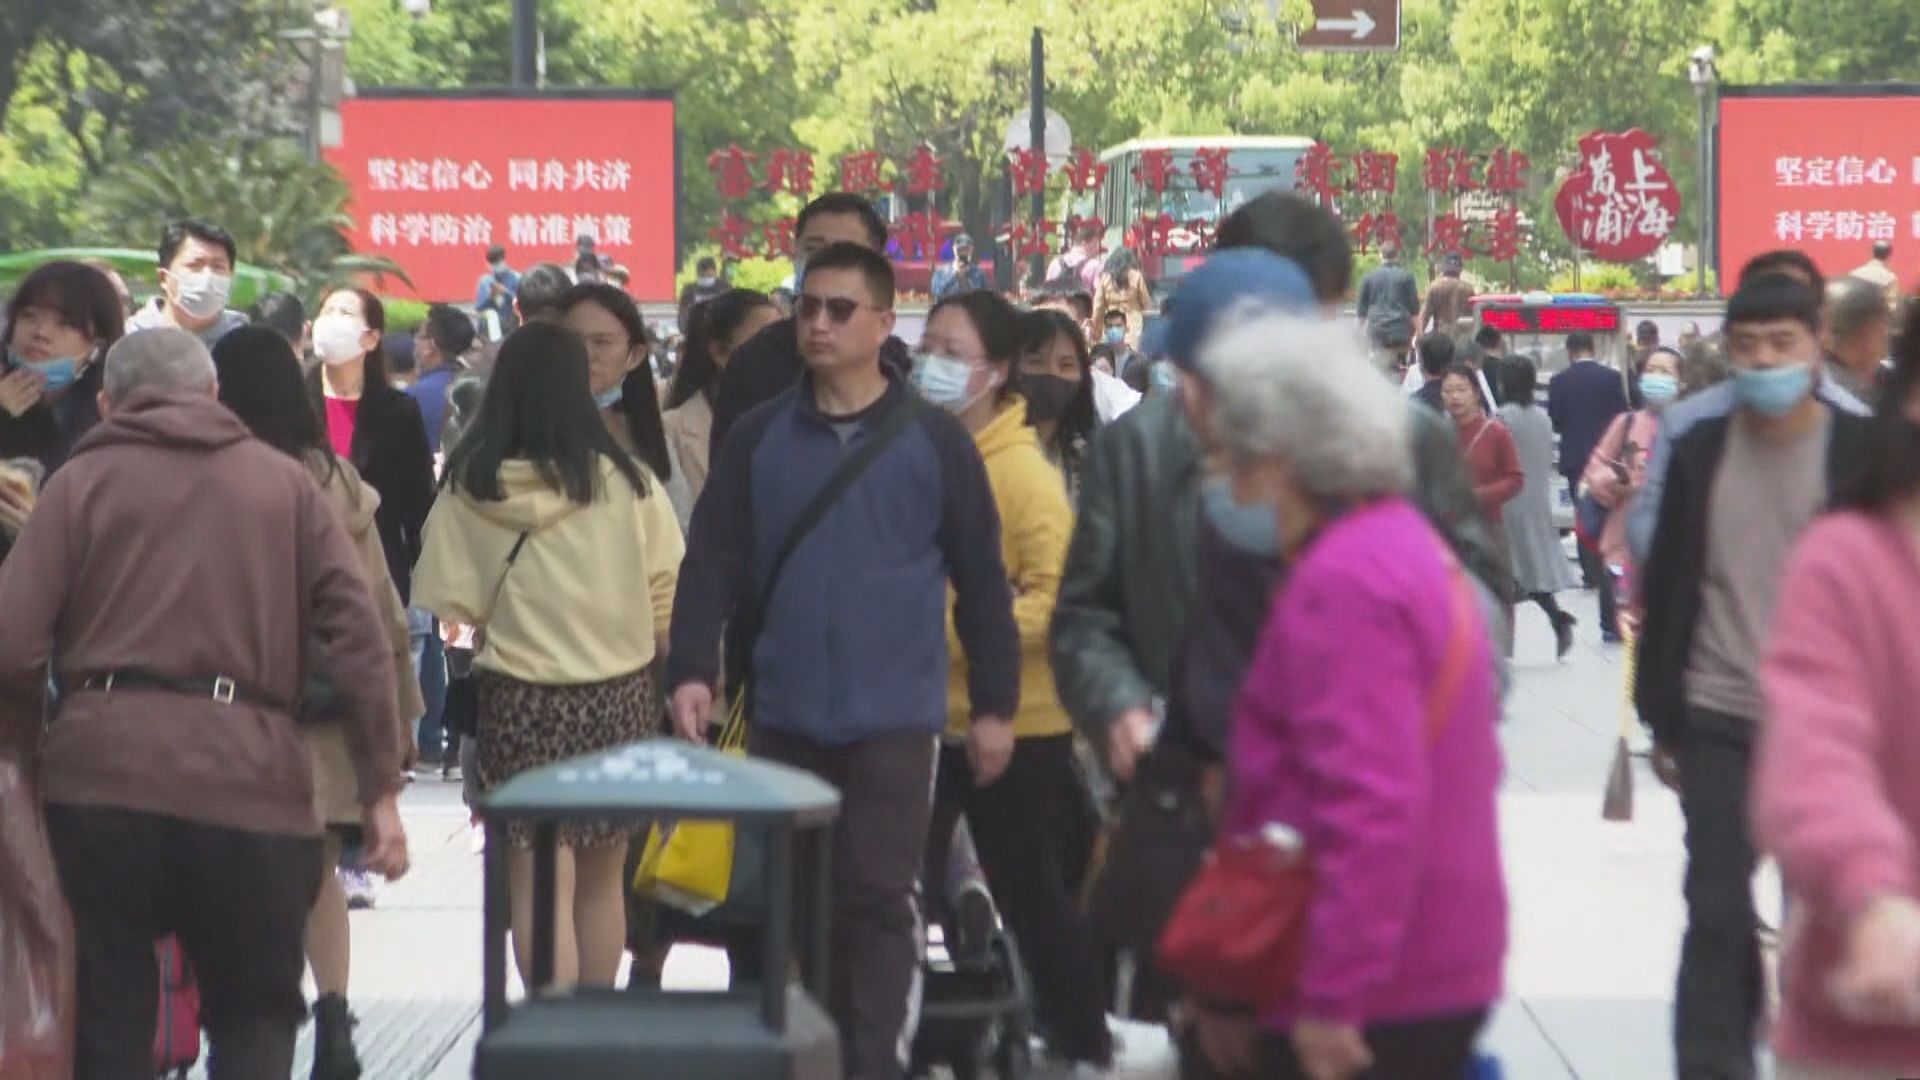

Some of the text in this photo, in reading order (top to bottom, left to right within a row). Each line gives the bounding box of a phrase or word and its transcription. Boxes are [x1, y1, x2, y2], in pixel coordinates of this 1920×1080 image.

[367, 157, 632, 193] 坚定信心 同舟共济
[1775, 155, 1897, 187] 坚定信心
[1623, 147, 1674, 239] 上海
[368, 211, 633, 247] 科学防治 精准施策
[1774, 209, 1897, 242] 科学防治
